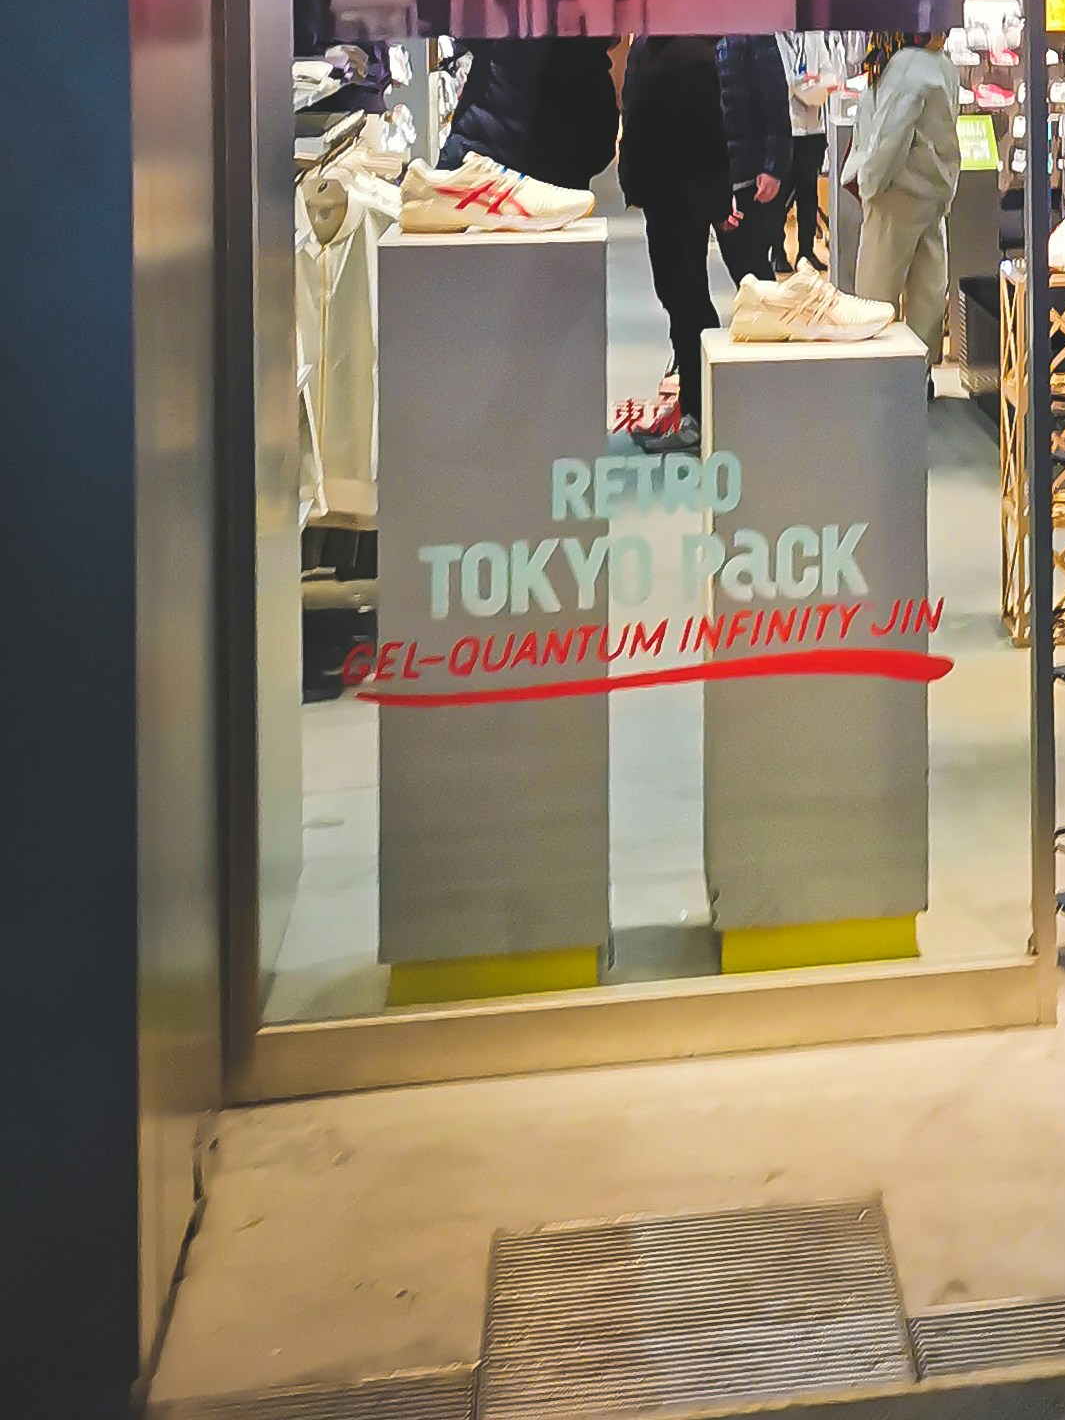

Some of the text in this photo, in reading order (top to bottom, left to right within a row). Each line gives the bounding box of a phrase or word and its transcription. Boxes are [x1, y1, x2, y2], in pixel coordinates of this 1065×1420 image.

[551, 450, 743, 521] RETRO
[418, 536, 652, 619] TOKYO
[342, 597, 946, 683] GEL-QUANTUM INFINITY JIN
